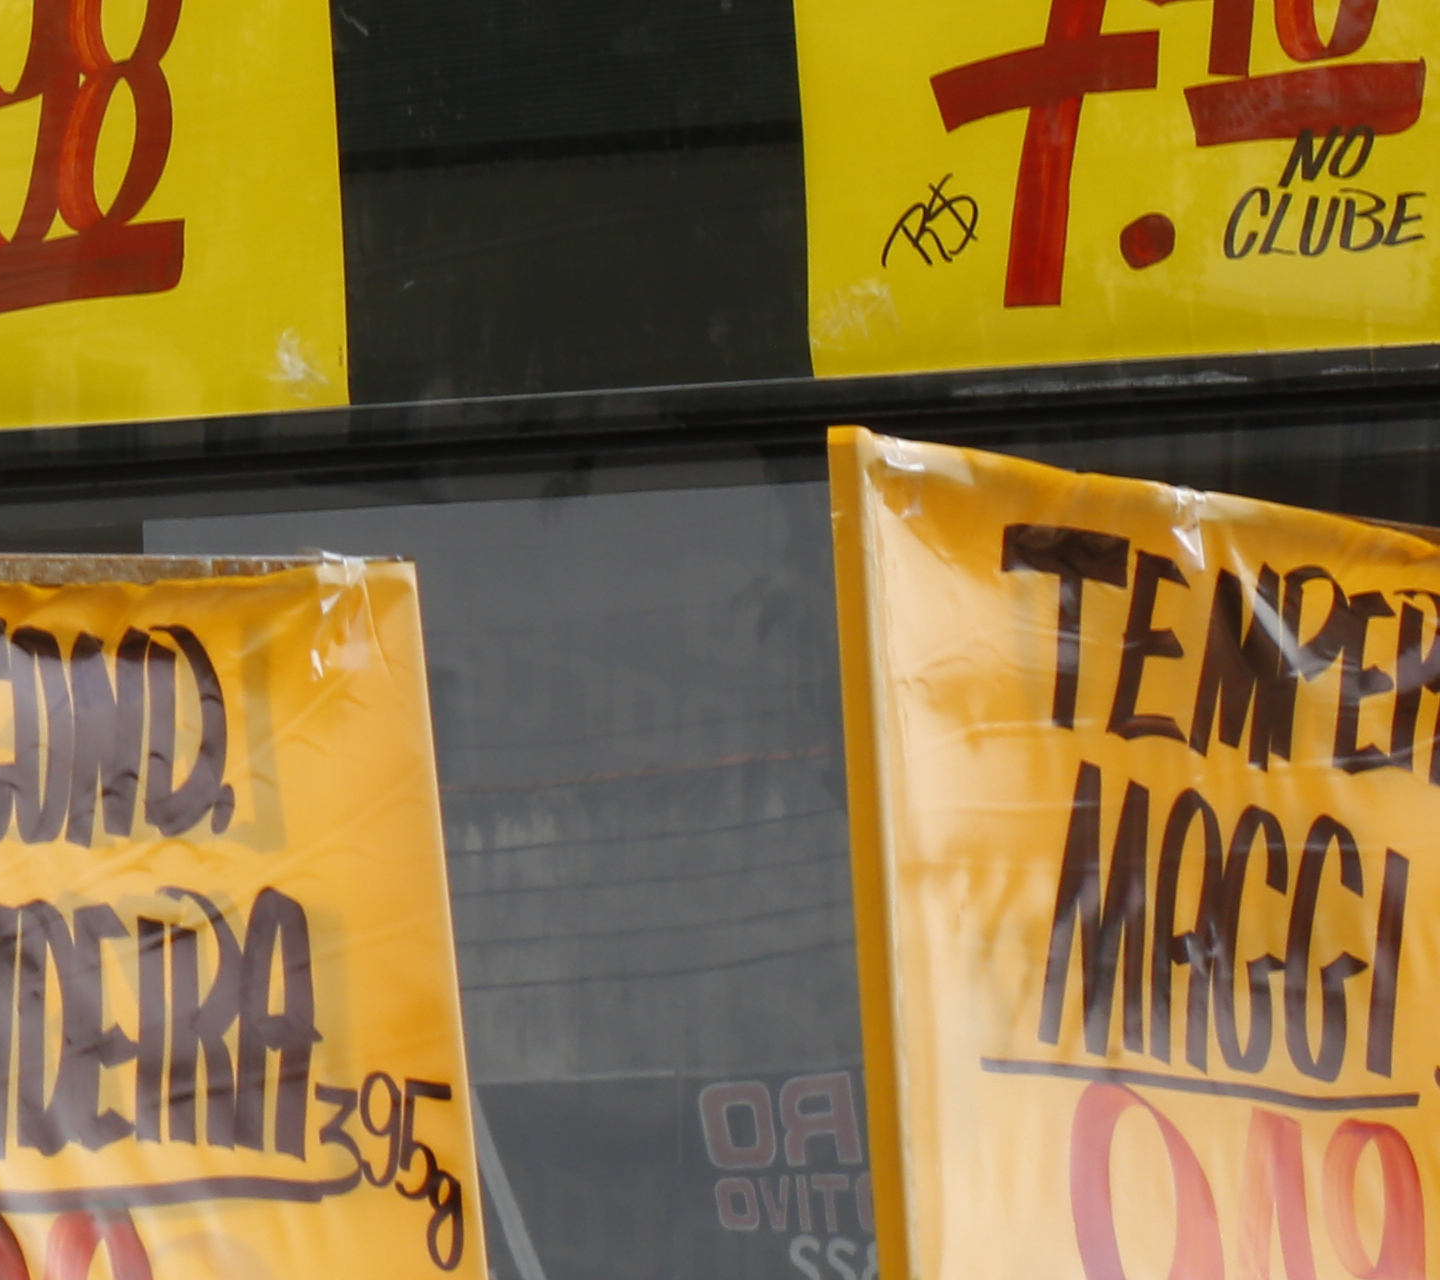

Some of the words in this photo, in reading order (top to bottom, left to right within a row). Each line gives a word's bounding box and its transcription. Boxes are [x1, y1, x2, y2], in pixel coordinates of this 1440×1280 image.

[1280, 125, 1375, 187] NO
[1223, 186, 1427, 260] CLUBE
[1037, 760, 1408, 1082] MAGGI
